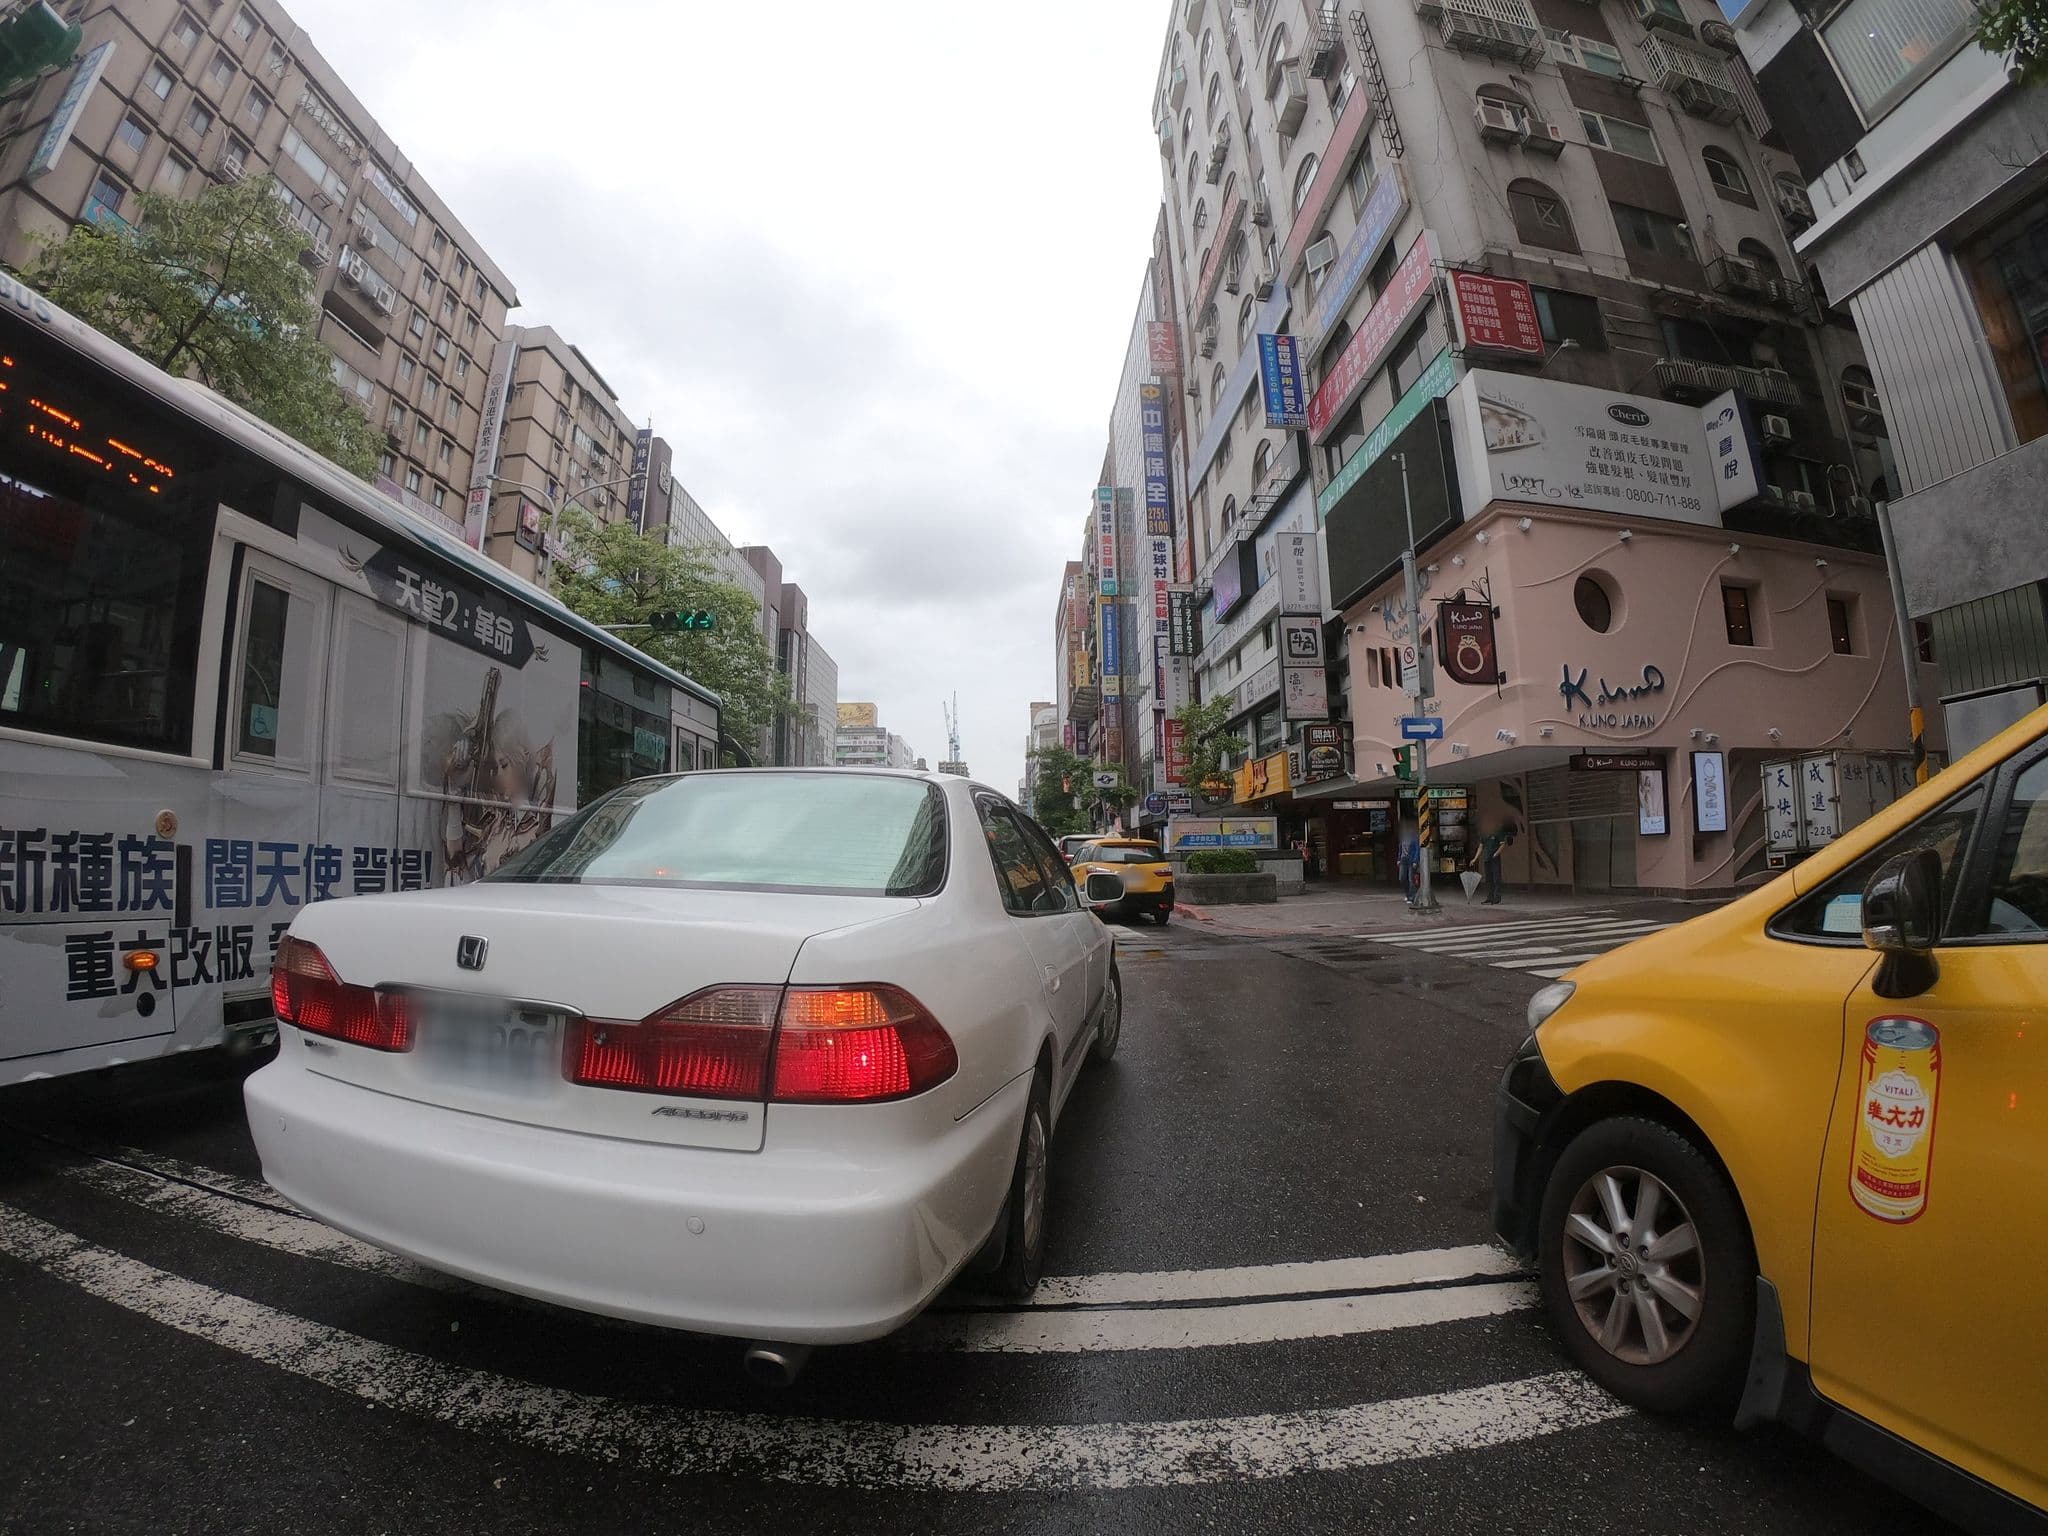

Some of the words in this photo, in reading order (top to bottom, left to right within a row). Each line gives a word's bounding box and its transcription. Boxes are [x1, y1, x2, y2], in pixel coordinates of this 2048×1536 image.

[1626, 487, 1701, 511] 0800-711-888
[1578, 713, 1617, 728] K.UNO
[1620, 714, 1655, 729] JAPAN
[205, 838, 343, 909] 闇天使
[1884, 1084, 1914, 1097] VITALI
[1866, 1099, 1926, 1130] 維大力
